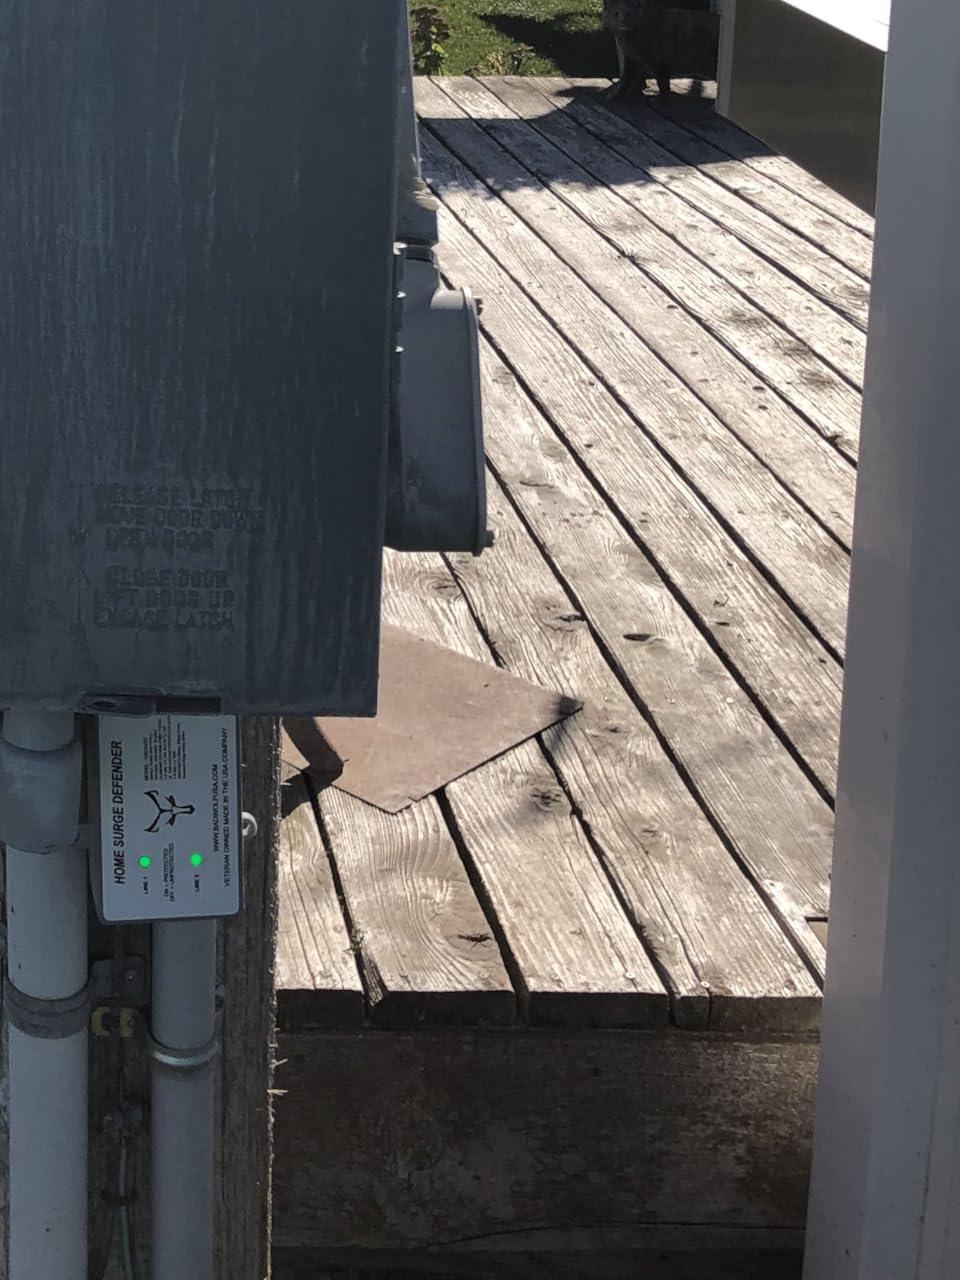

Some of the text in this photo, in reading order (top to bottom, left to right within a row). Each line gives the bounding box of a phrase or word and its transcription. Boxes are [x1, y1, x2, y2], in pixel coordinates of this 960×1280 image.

[220, 727, 229, 763] COMPANY
[221, 763, 229, 779] USA
[111, 739, 126, 886] HOME SURGE DEFENDER
[222, 803, 230, 825] MADE
[223, 854, 231, 888] VETERAN
